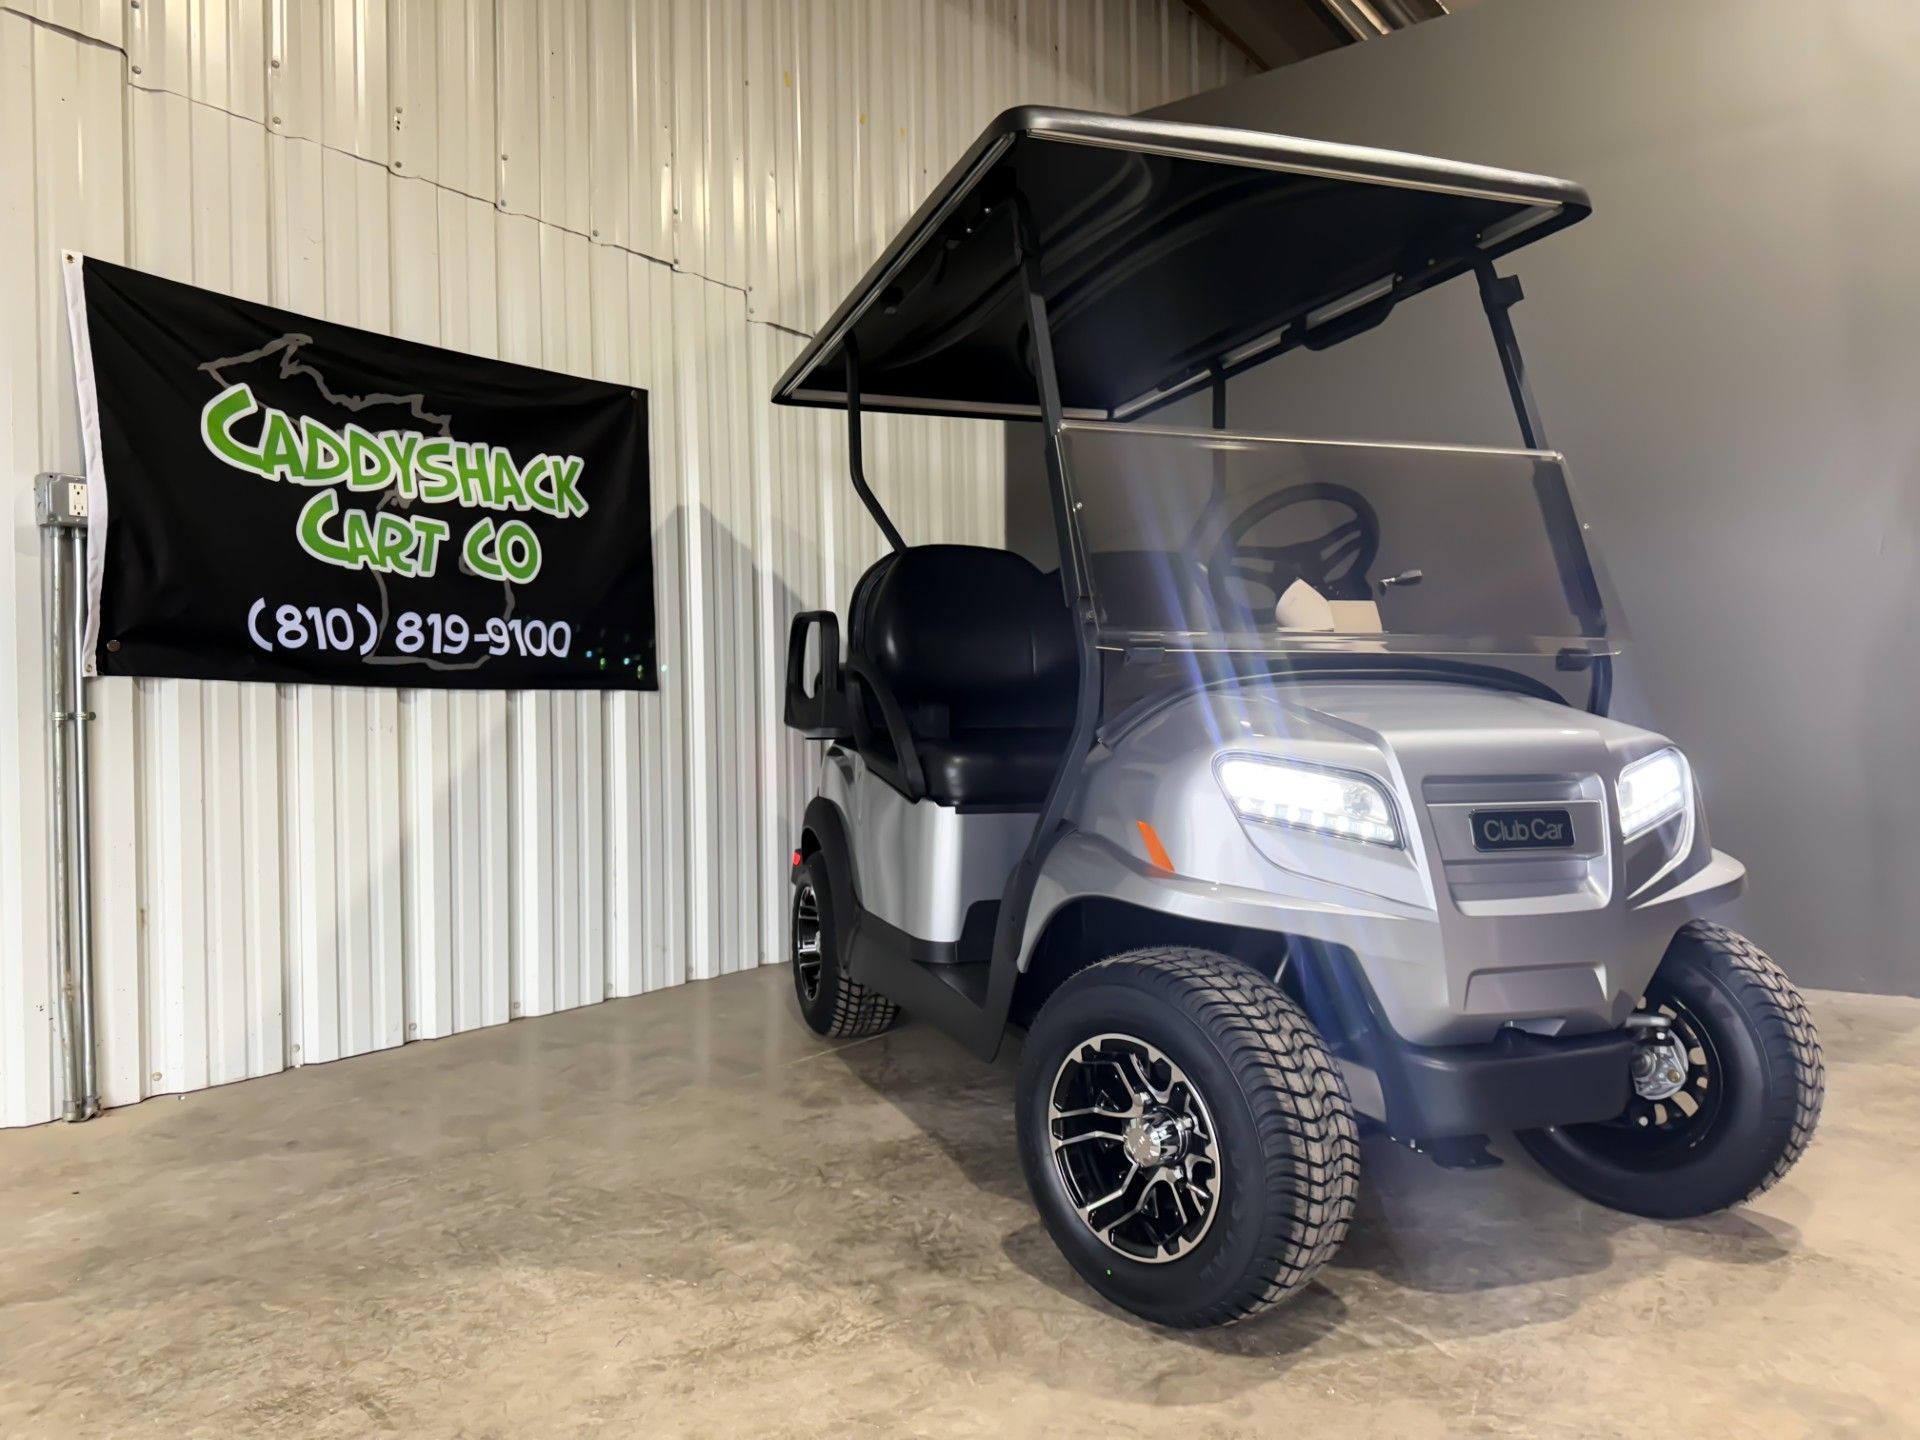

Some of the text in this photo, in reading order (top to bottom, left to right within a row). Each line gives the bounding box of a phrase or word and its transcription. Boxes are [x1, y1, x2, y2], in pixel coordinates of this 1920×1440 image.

[201, 383, 588, 518] CADDYSHACK
[296, 488, 542, 584] CART CO
[247, 597, 572, 658] (810) 819-9100
[1483, 818, 1563, 841] Club Car
